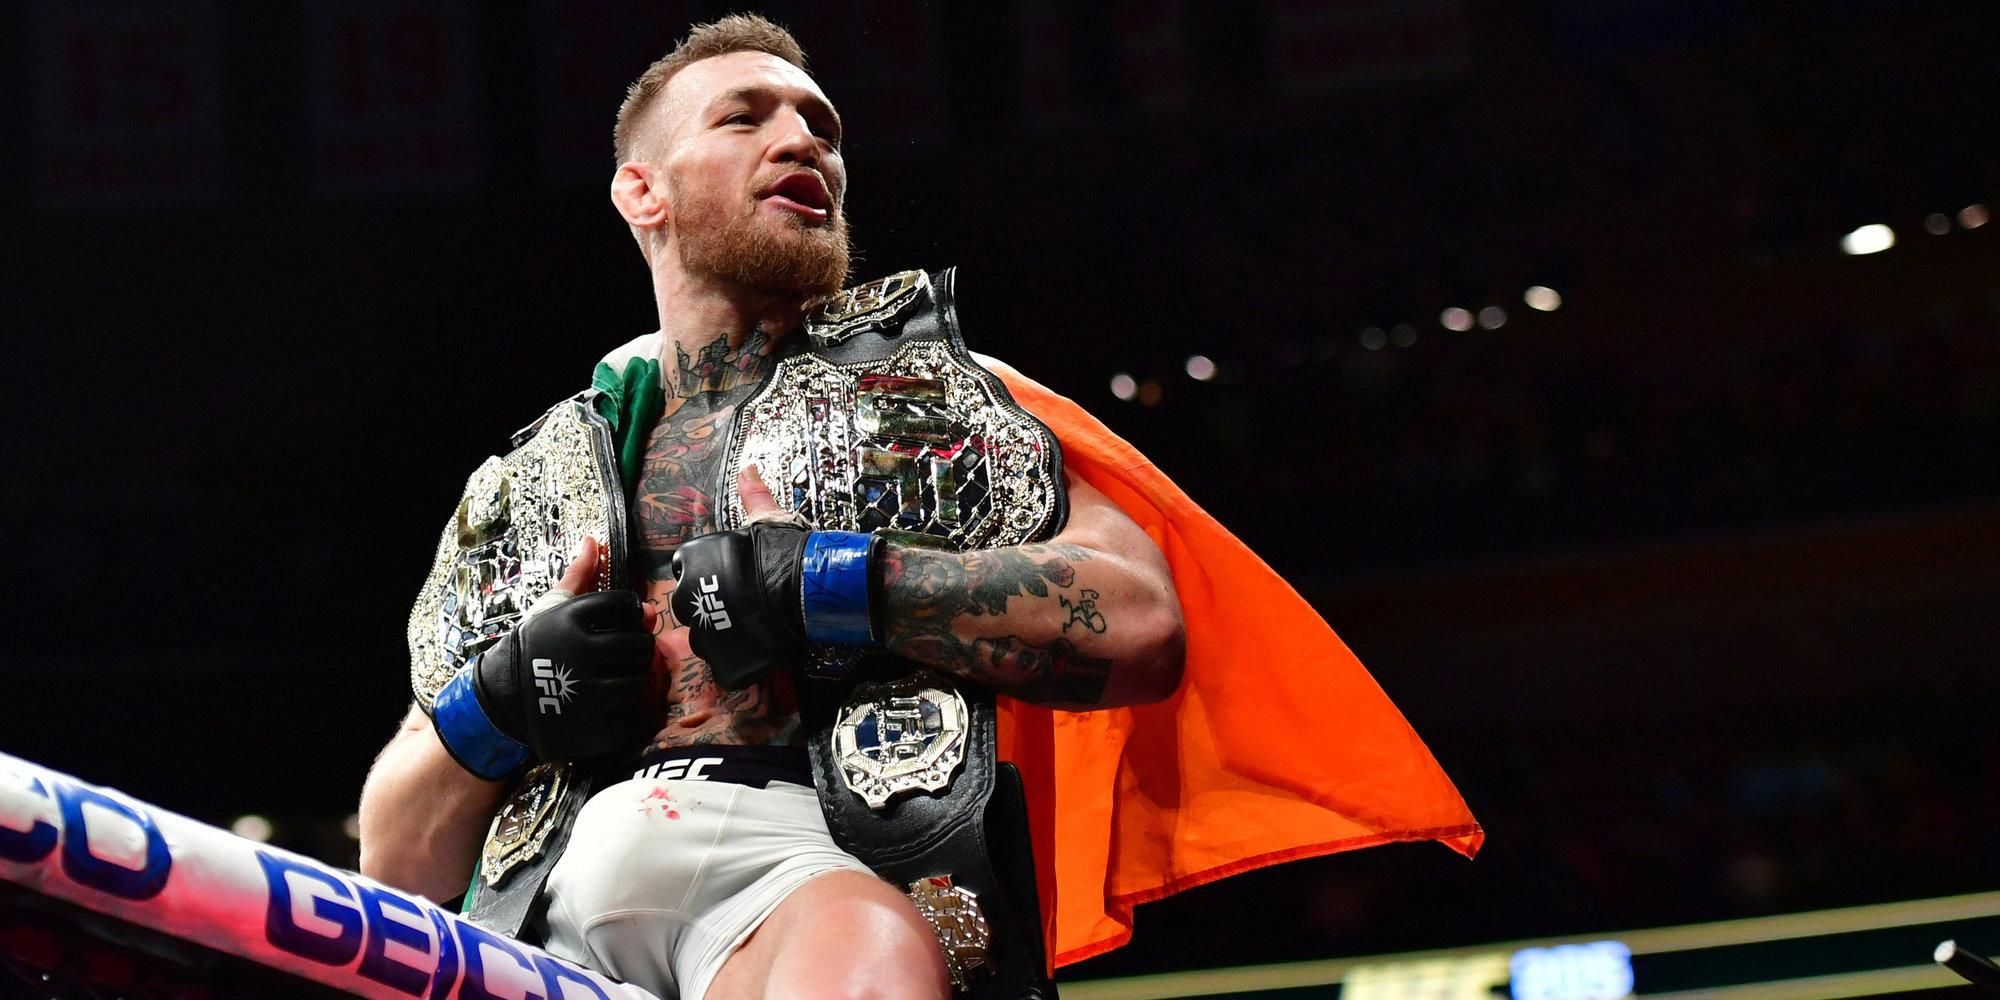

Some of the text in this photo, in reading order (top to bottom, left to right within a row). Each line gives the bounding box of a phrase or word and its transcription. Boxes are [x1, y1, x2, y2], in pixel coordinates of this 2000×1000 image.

[699, 574, 732, 631] UFC
[532, 658, 562, 715] UFC
[632, 757, 724, 781] UFC
